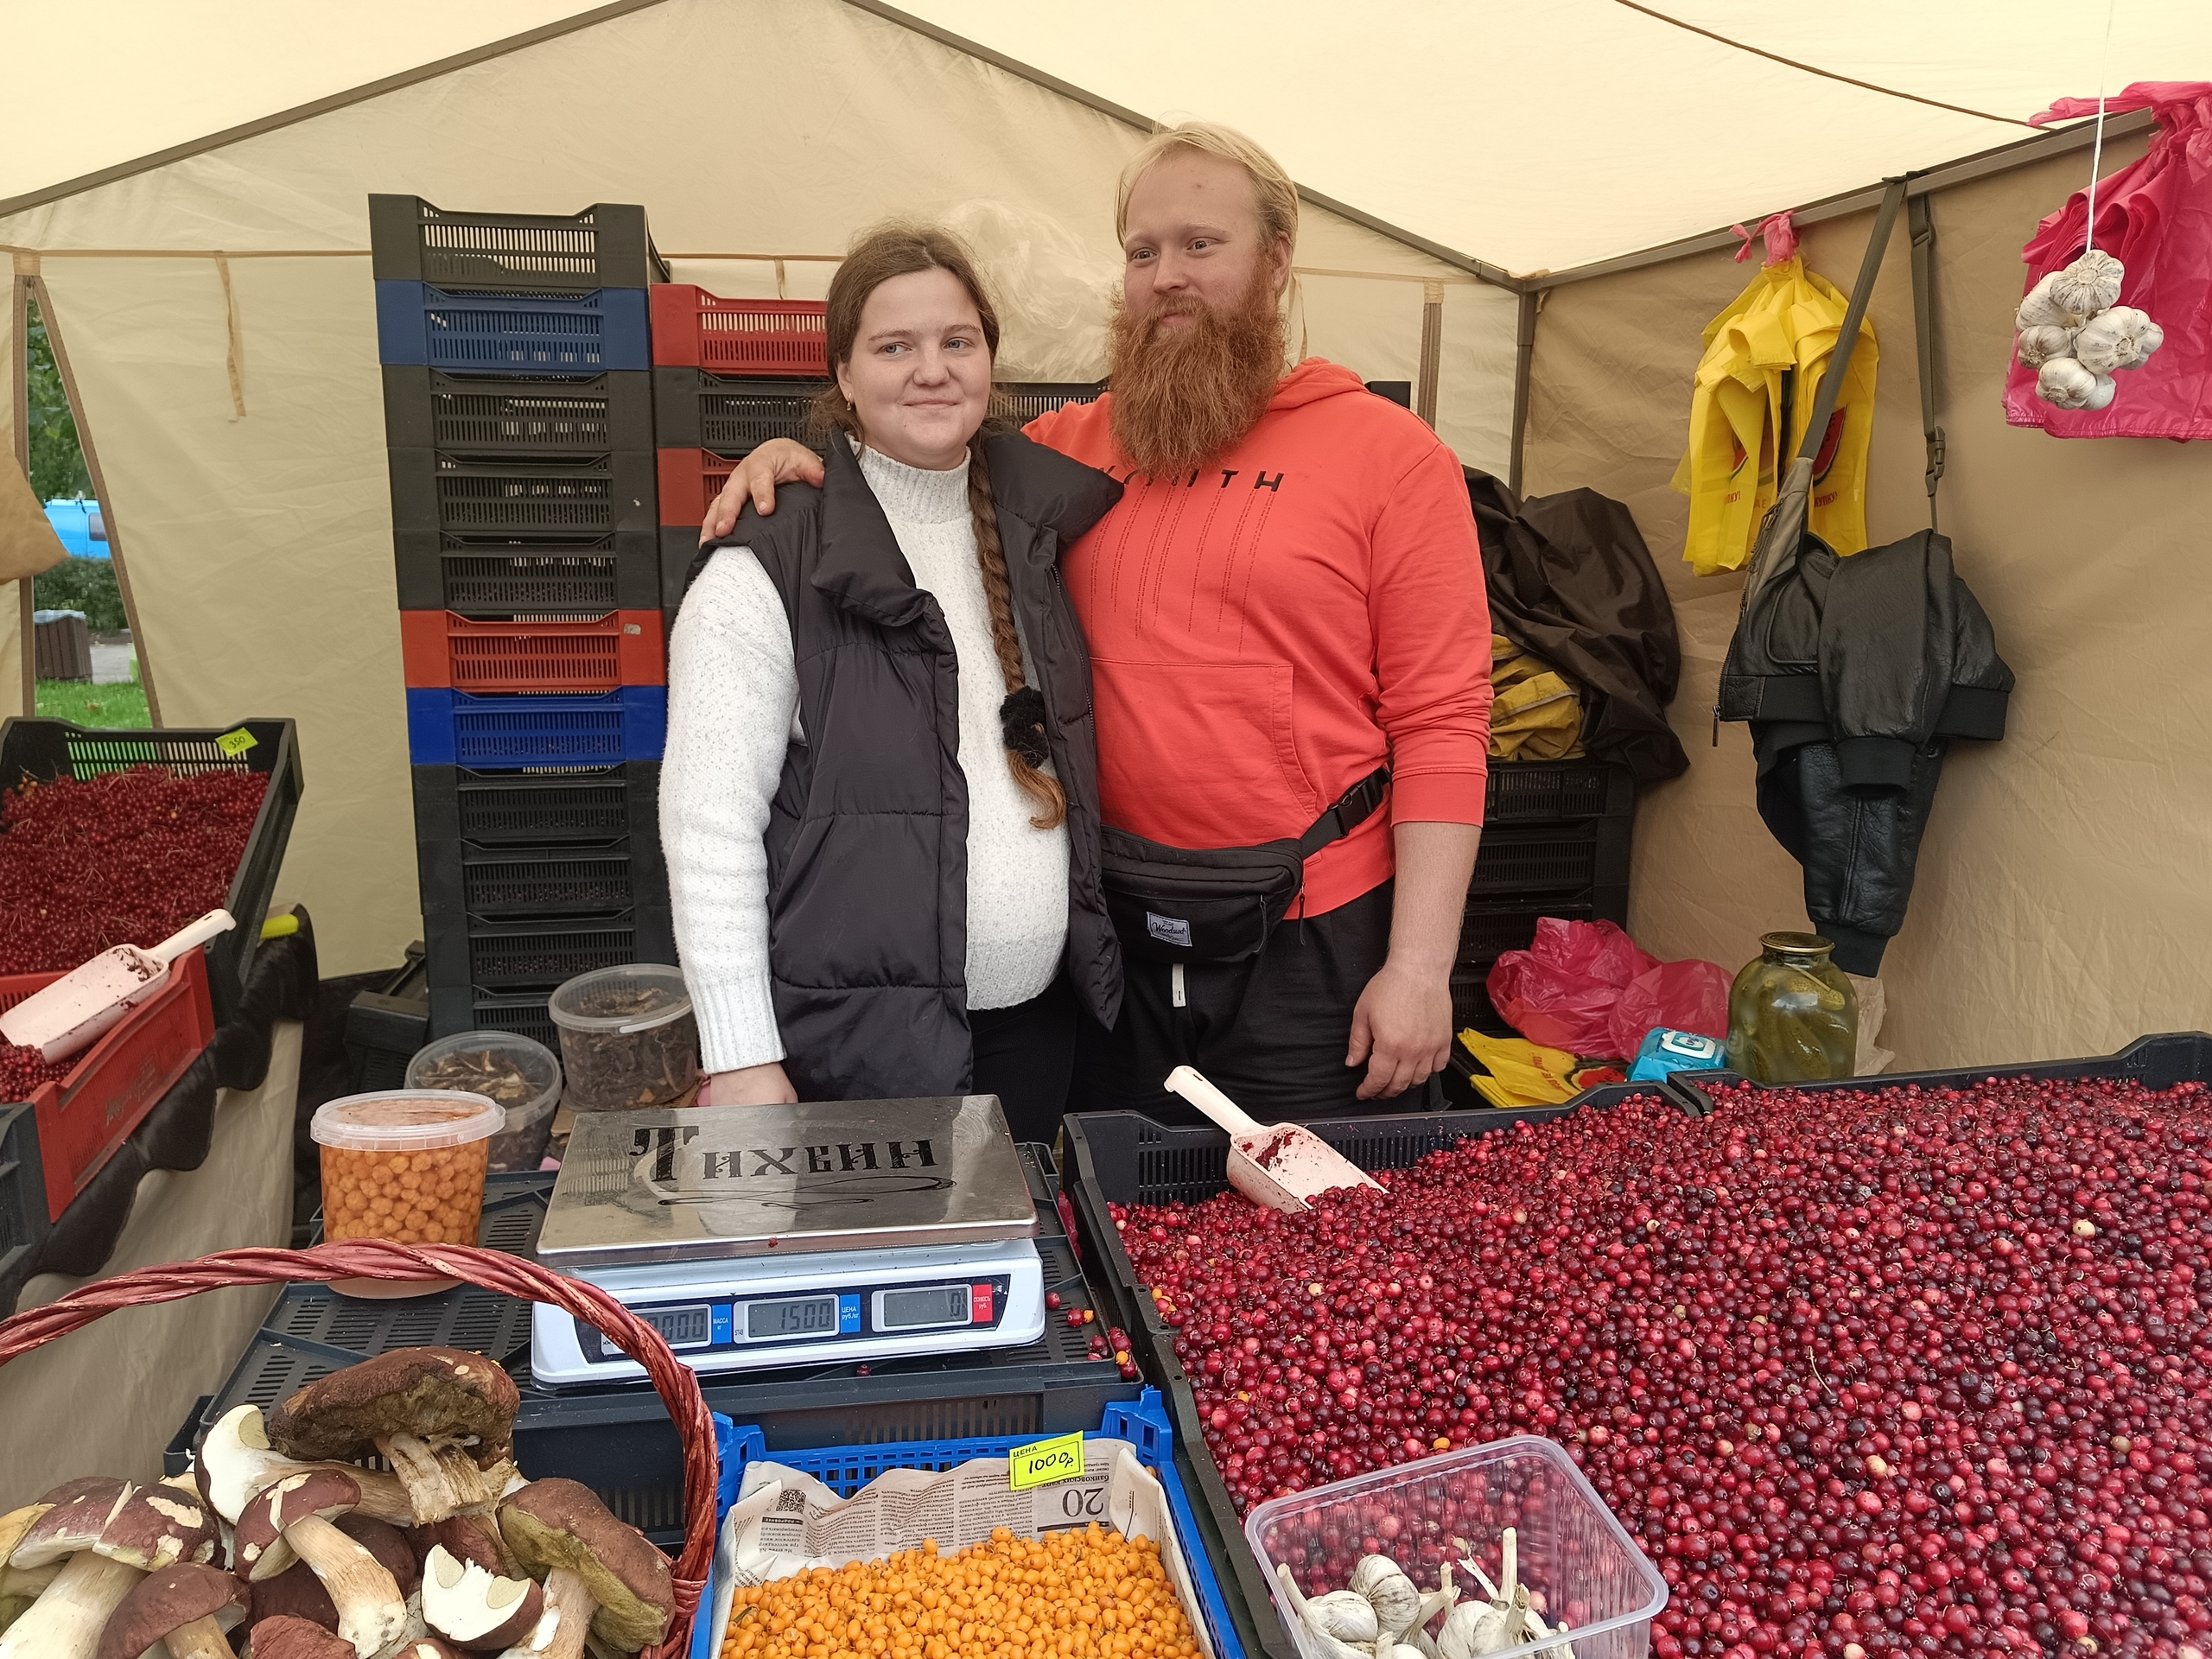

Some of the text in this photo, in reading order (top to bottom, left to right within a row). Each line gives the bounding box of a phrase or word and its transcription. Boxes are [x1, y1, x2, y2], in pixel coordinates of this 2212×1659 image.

[229, 735, 245, 748] 350
[780, 1302, 832, 1331] 1500
[842, 1306, 857, 1314] ЦЕНА
[1013, 1446, 1038, 1458] ЦЕНА
[1062, 1488, 1104, 1517] 20
